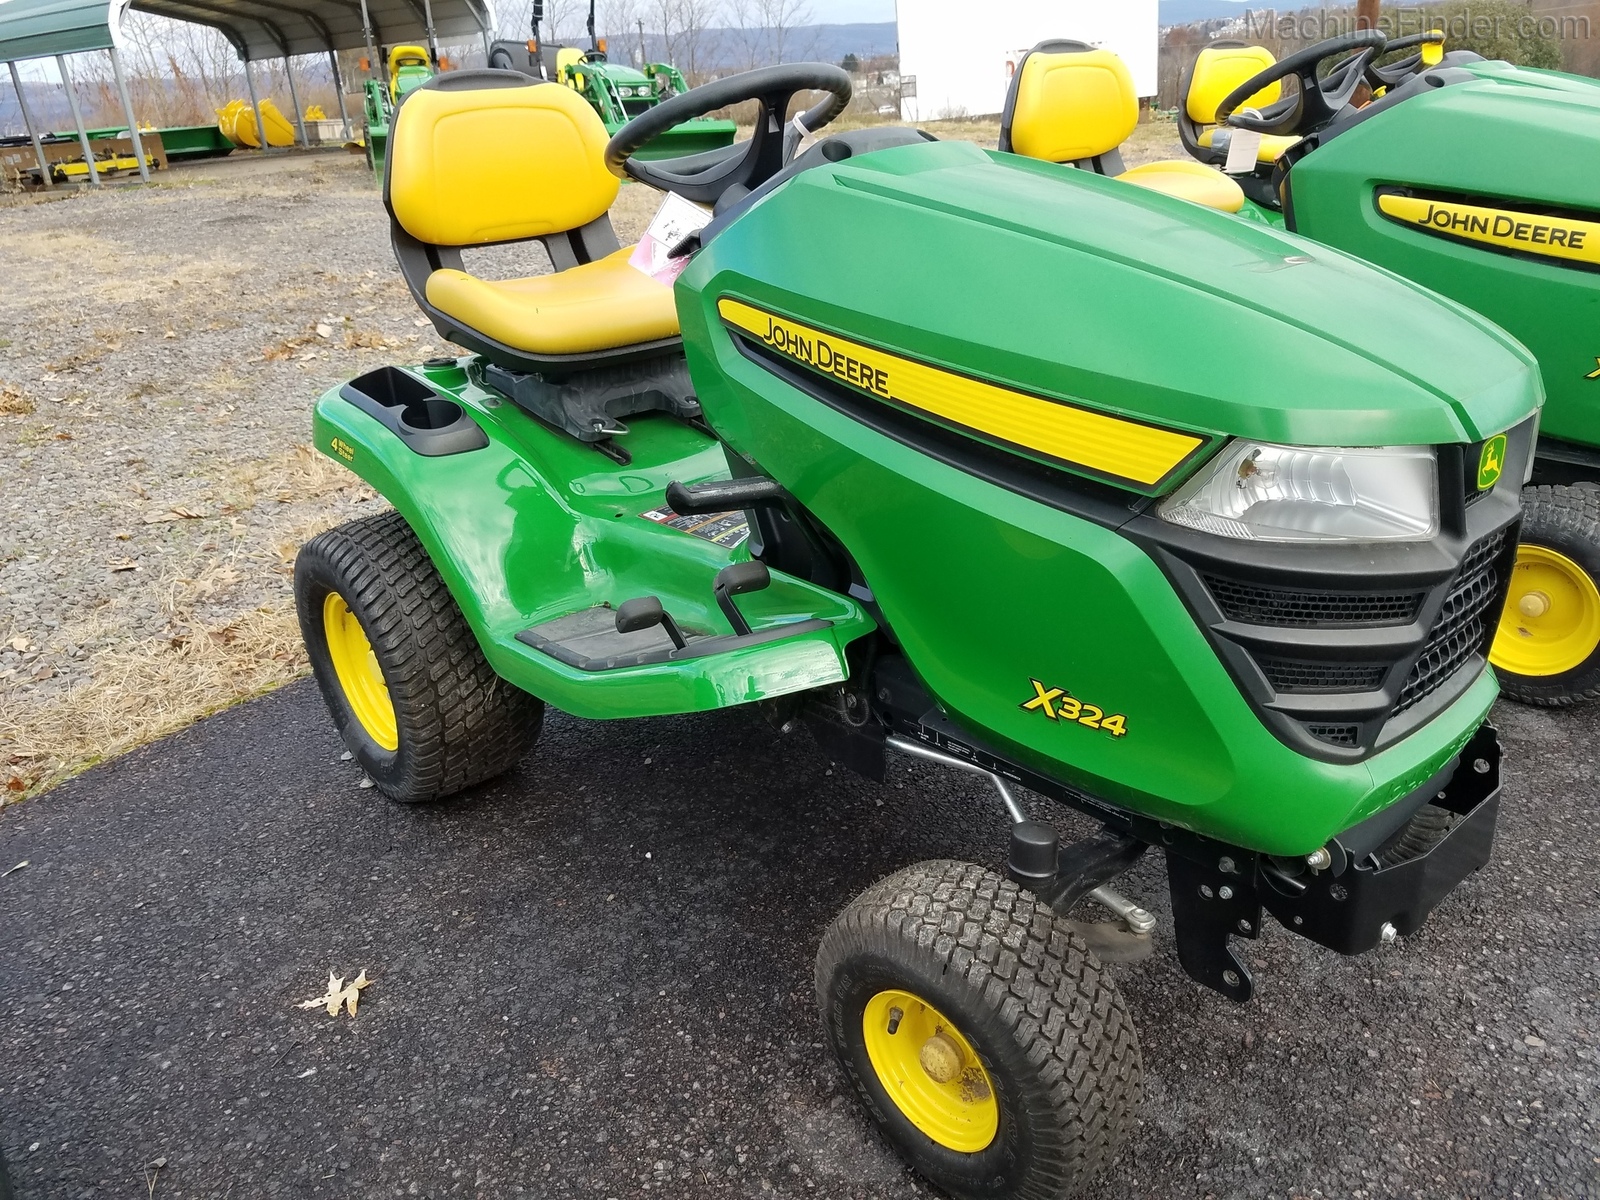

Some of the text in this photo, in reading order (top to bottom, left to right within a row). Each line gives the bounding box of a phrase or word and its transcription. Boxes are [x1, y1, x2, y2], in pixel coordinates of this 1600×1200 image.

[1418, 204, 1587, 250] JOHN DEERE
[763, 317, 889, 396] JOHN DEERE
[331, 437, 338, 452] 4
[1019, 677, 1128, 737] X324
